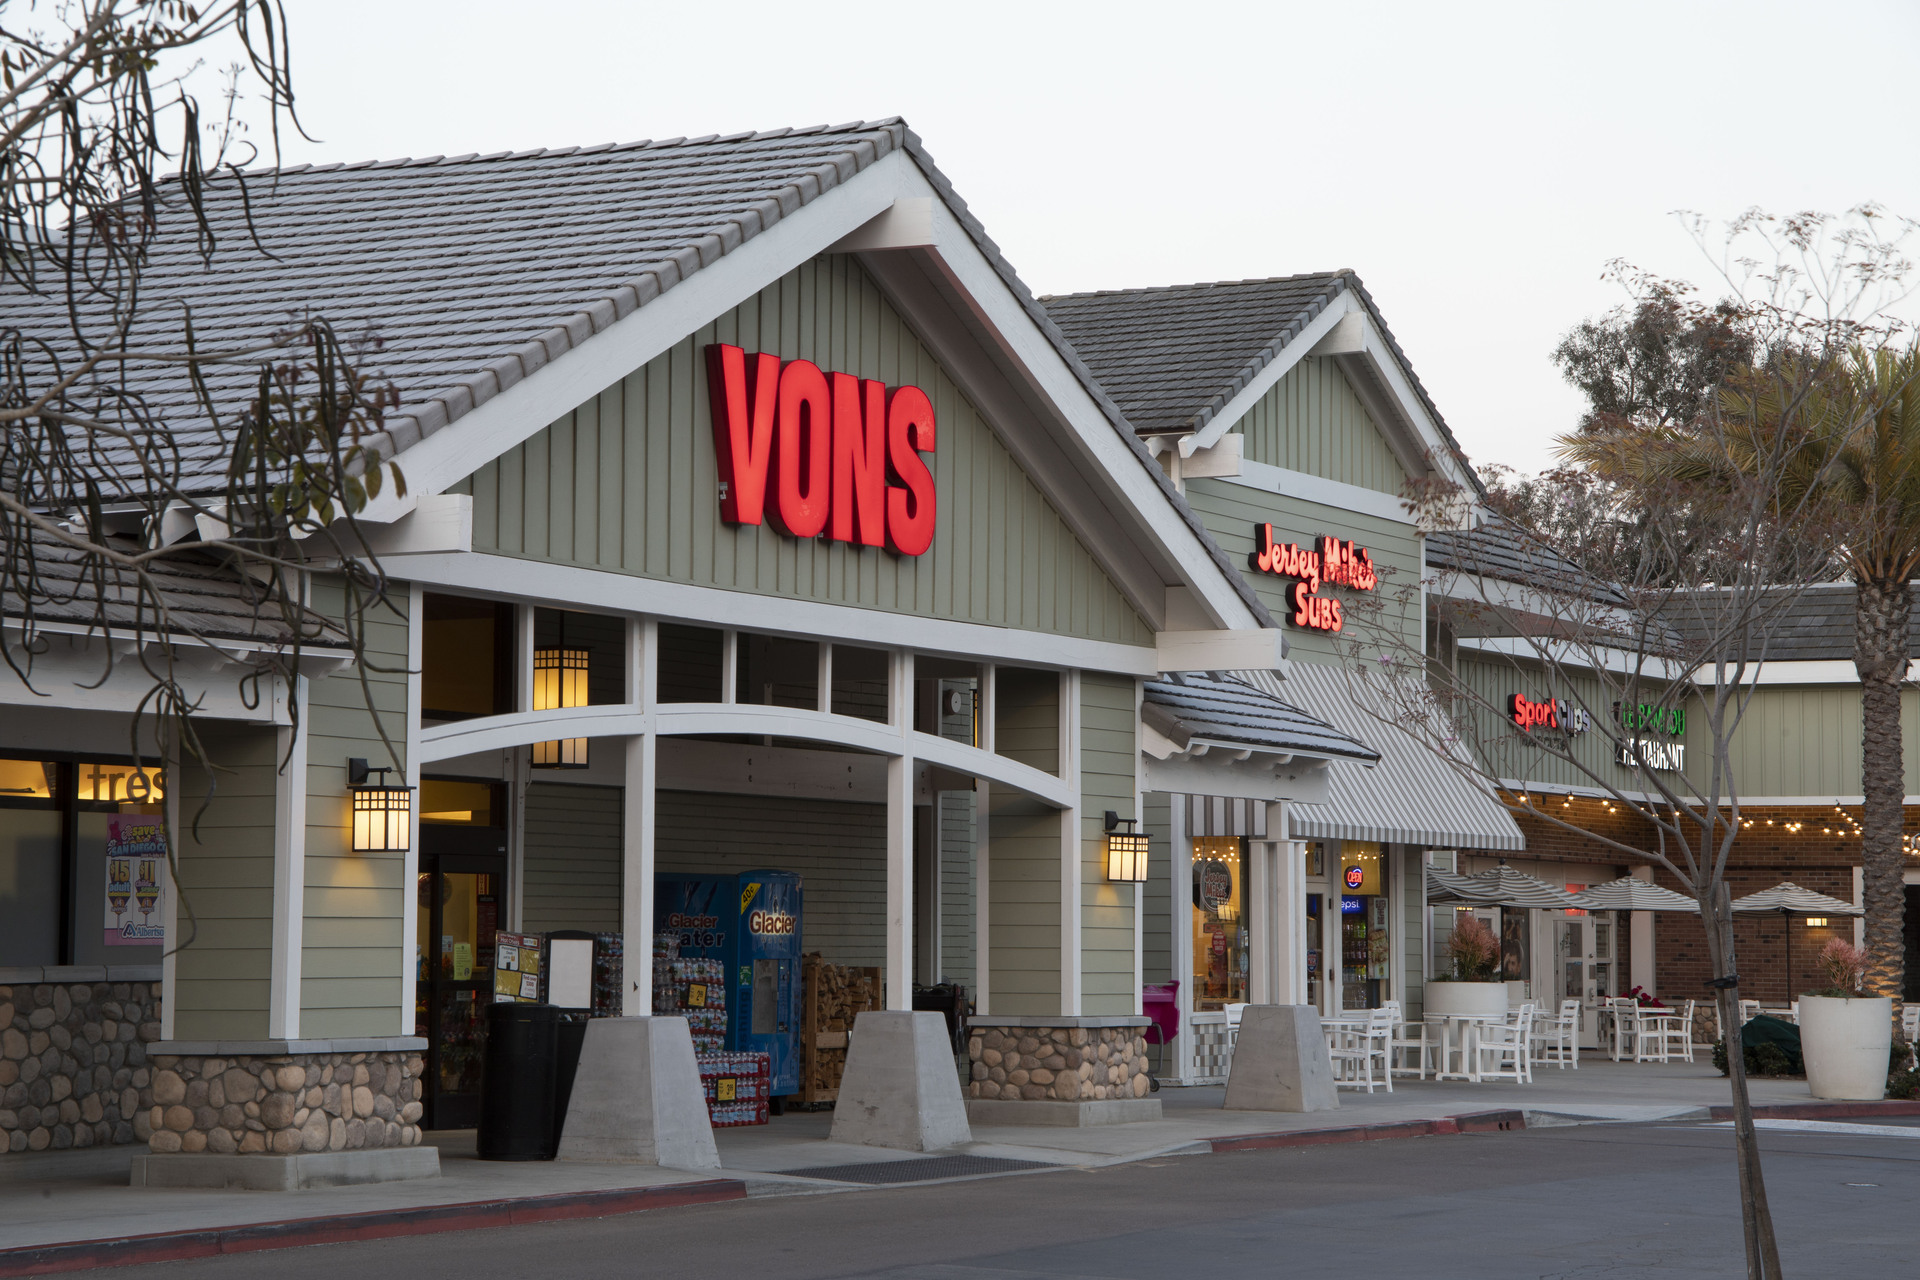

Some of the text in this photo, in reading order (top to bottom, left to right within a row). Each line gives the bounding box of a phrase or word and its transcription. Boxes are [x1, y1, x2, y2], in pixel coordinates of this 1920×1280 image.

[714, 343, 937, 557] VONS
[1257, 522, 1378, 594] Jersey Mike's
[132, 825, 156, 837] save
[111, 844, 130, 857] SAN
[130, 841, 156, 855] DIEGO
[110, 860, 131, 882] $15
[139, 861, 156, 882] $11
[1347, 871, 1363, 883] OPEN
[109, 882, 132, 893] adult
[668, 913, 719, 929] Glacier
[750, 910, 797, 935] Glacier
